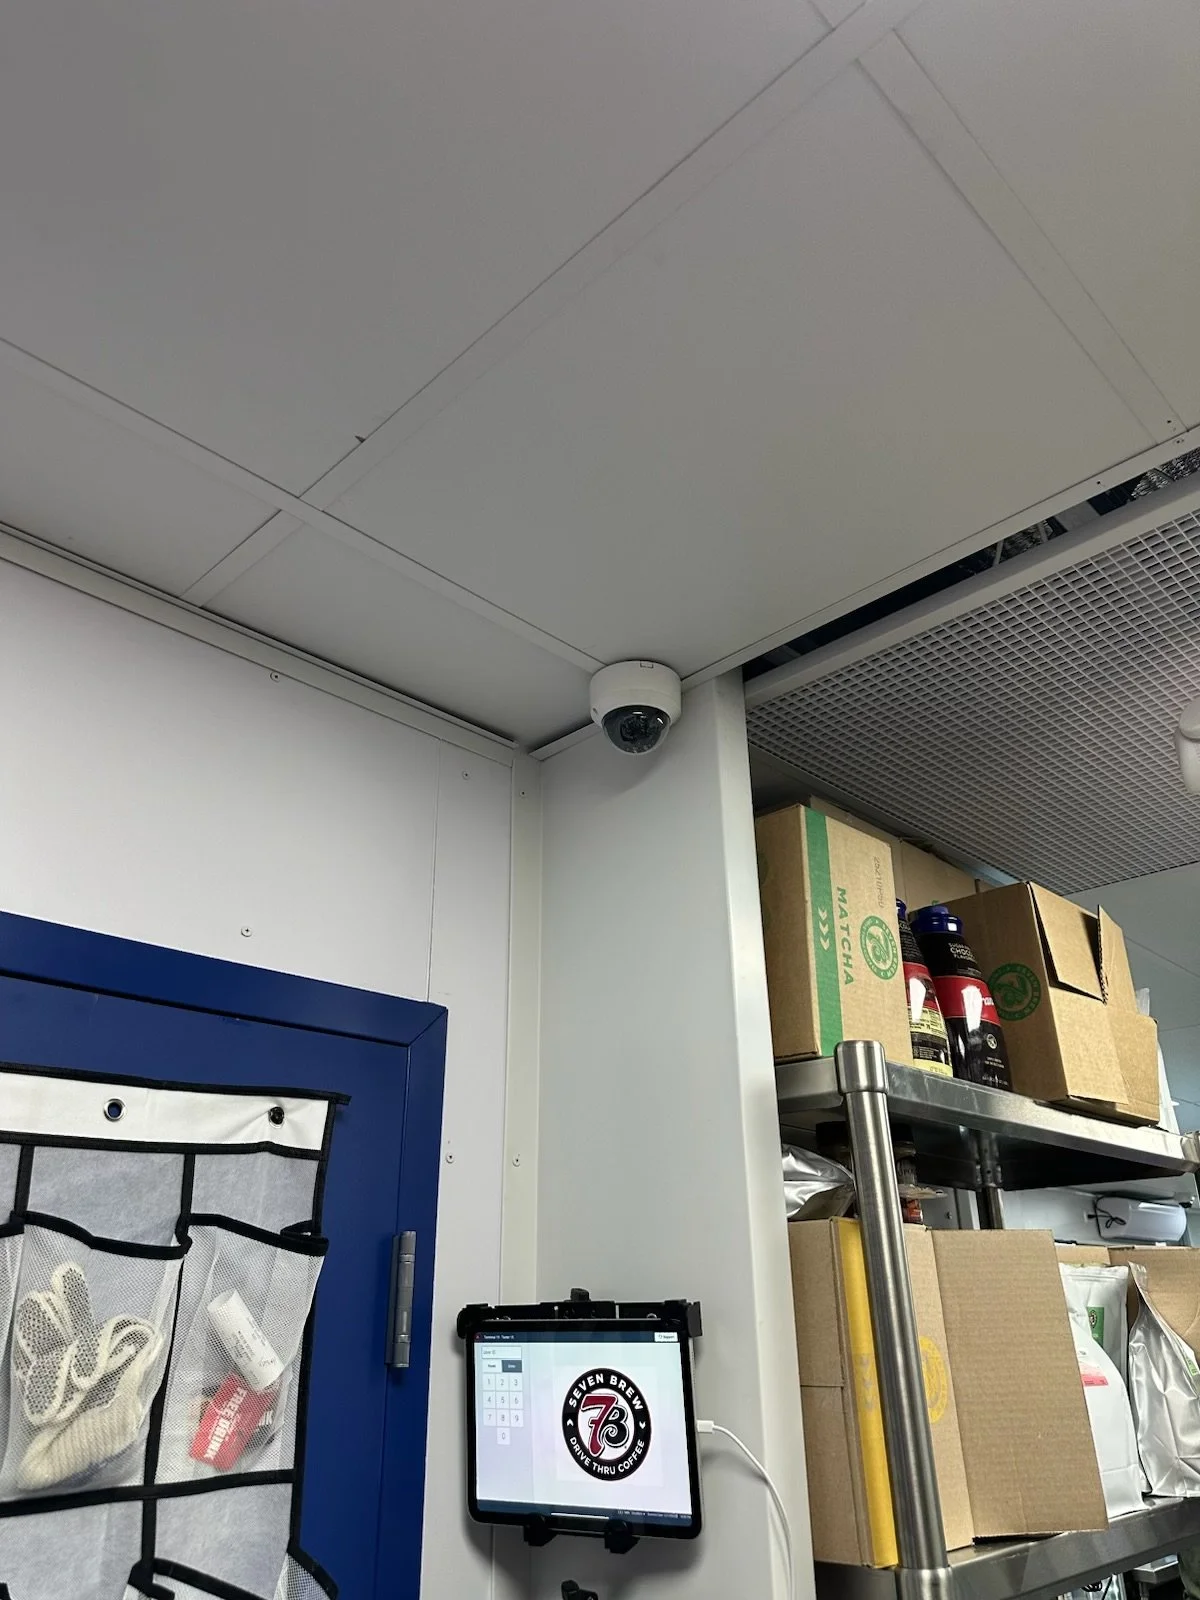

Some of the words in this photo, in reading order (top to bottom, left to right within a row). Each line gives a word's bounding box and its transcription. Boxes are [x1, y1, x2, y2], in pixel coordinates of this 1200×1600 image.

[837, 886, 854, 985] MATCHA
[221, 1387, 249, 1419] FREE
[568, 1373, 604, 1408] SEVEN
[609, 1375, 643, 1410] BREW
[203, 1418, 231, 1460] DRINK
[569, 1436, 592, 1467] DRIVE
[592, 1462, 616, 1475] THRU
[618, 1439, 645, 1473] COFFEE
